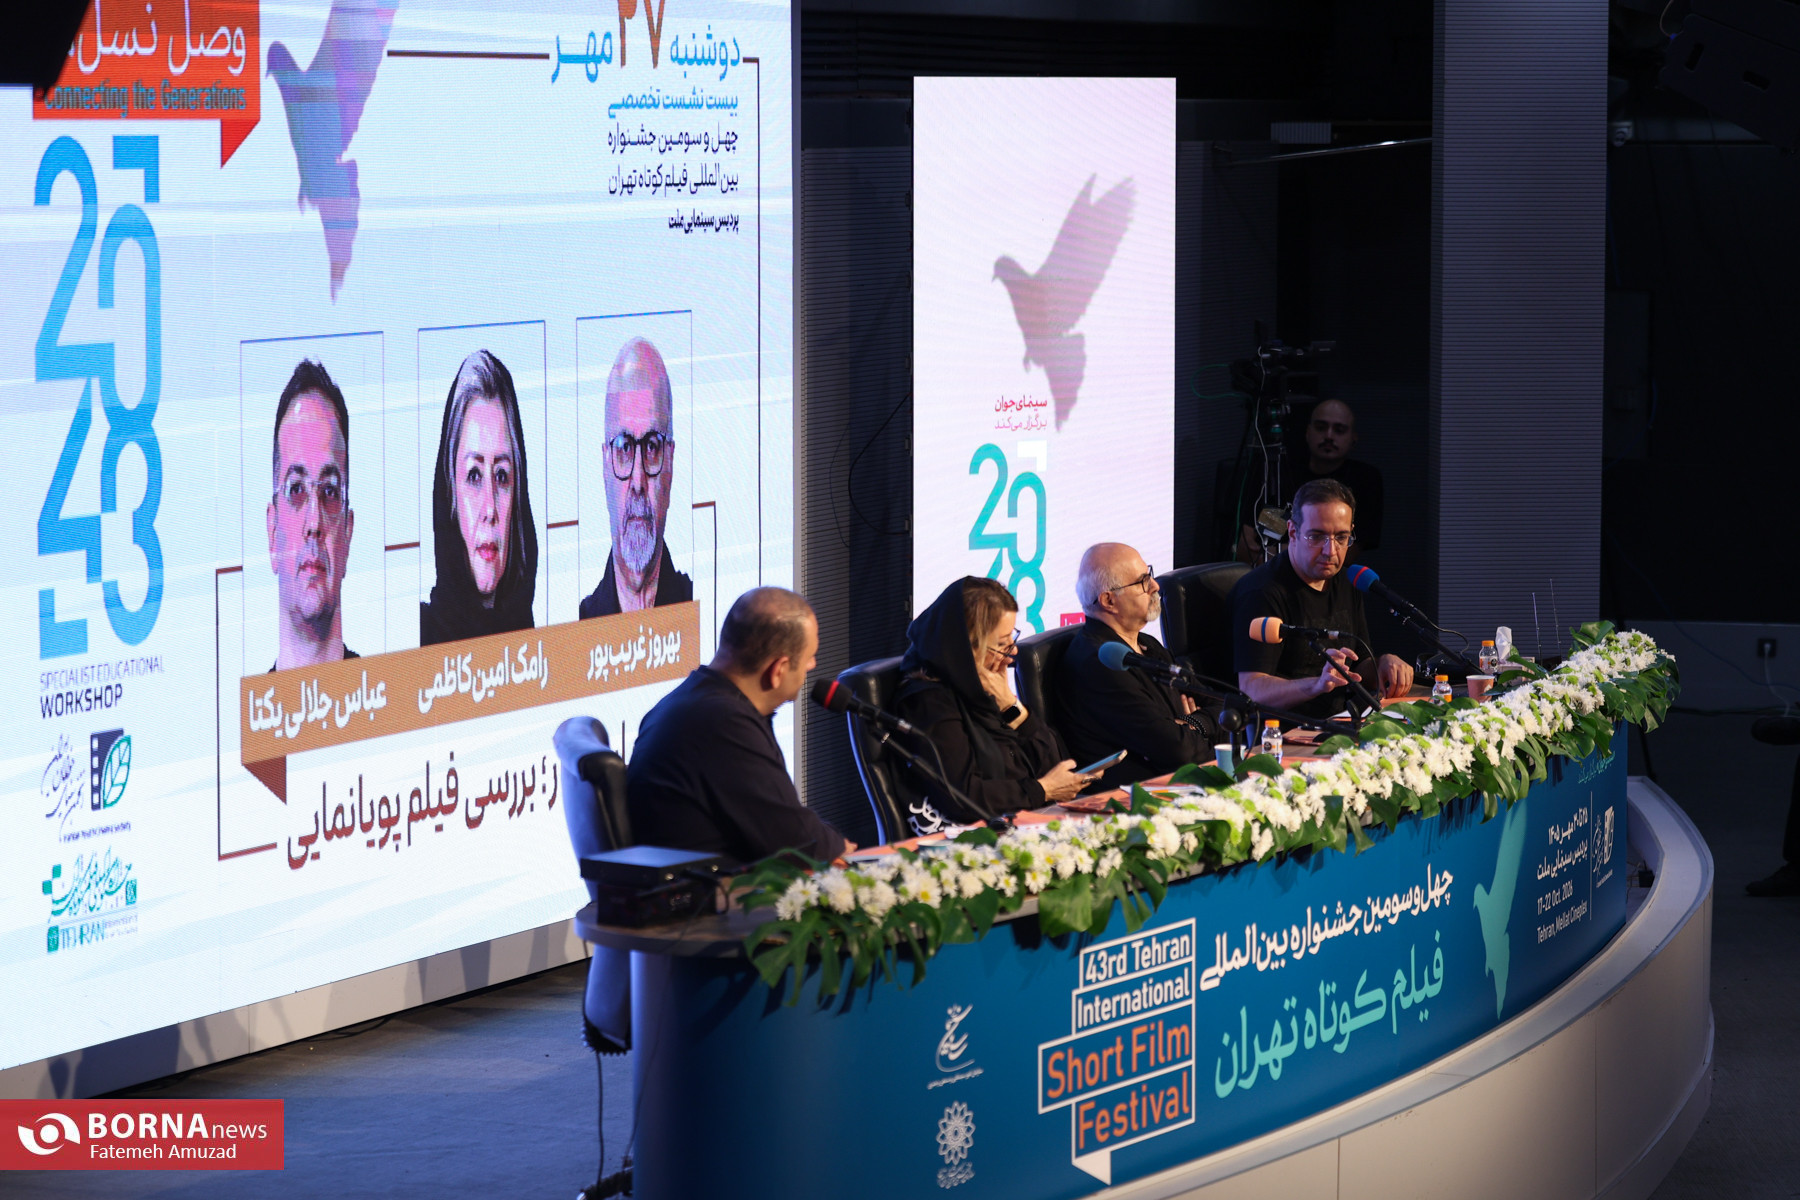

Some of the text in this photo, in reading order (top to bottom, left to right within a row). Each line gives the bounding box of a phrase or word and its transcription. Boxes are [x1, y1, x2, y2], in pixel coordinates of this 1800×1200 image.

[168, 0, 246, 75] وصل
[551, 30, 613, 84] مهر
[670, 24, 740, 81] دوشنبه
[132, 78, 156, 110] the
[160, 78, 246, 110] Generations
[662, 85, 704, 110] نشست
[706, 95, 738, 117] بیست
[608, 120, 656, 154] جشنواره
[608, 164, 637, 197] تهران
[638, 163, 663, 195] کوتاه
[664, 162, 688, 198] فیلم
[511, 640, 548, 690] رامک
[646, 627, 681, 670] بهروز
[40, 656, 164, 692] SPECIALIST EDUCATIONAL
[40, 683, 123, 719] WORKSHOP
[249, 670, 387, 739] عباس جلالی یکتا
[407, 751, 459, 847] فیلم
[465, 764, 536, 829] بررسی
[287, 774, 401, 870] پویانمایی
[1290, 901, 1363, 960] جشنواره
[1555, 910, 1570, 933] Mellat
[1085, 934, 1190, 983] 43rd Tehran
[1077, 967, 1190, 1029] International
[1215, 929, 1444, 1099] فیلم کوتاه تهران
[1047, 1020, 1190, 1098] Short Film
[1078, 1071, 1190, 1149] Festival
